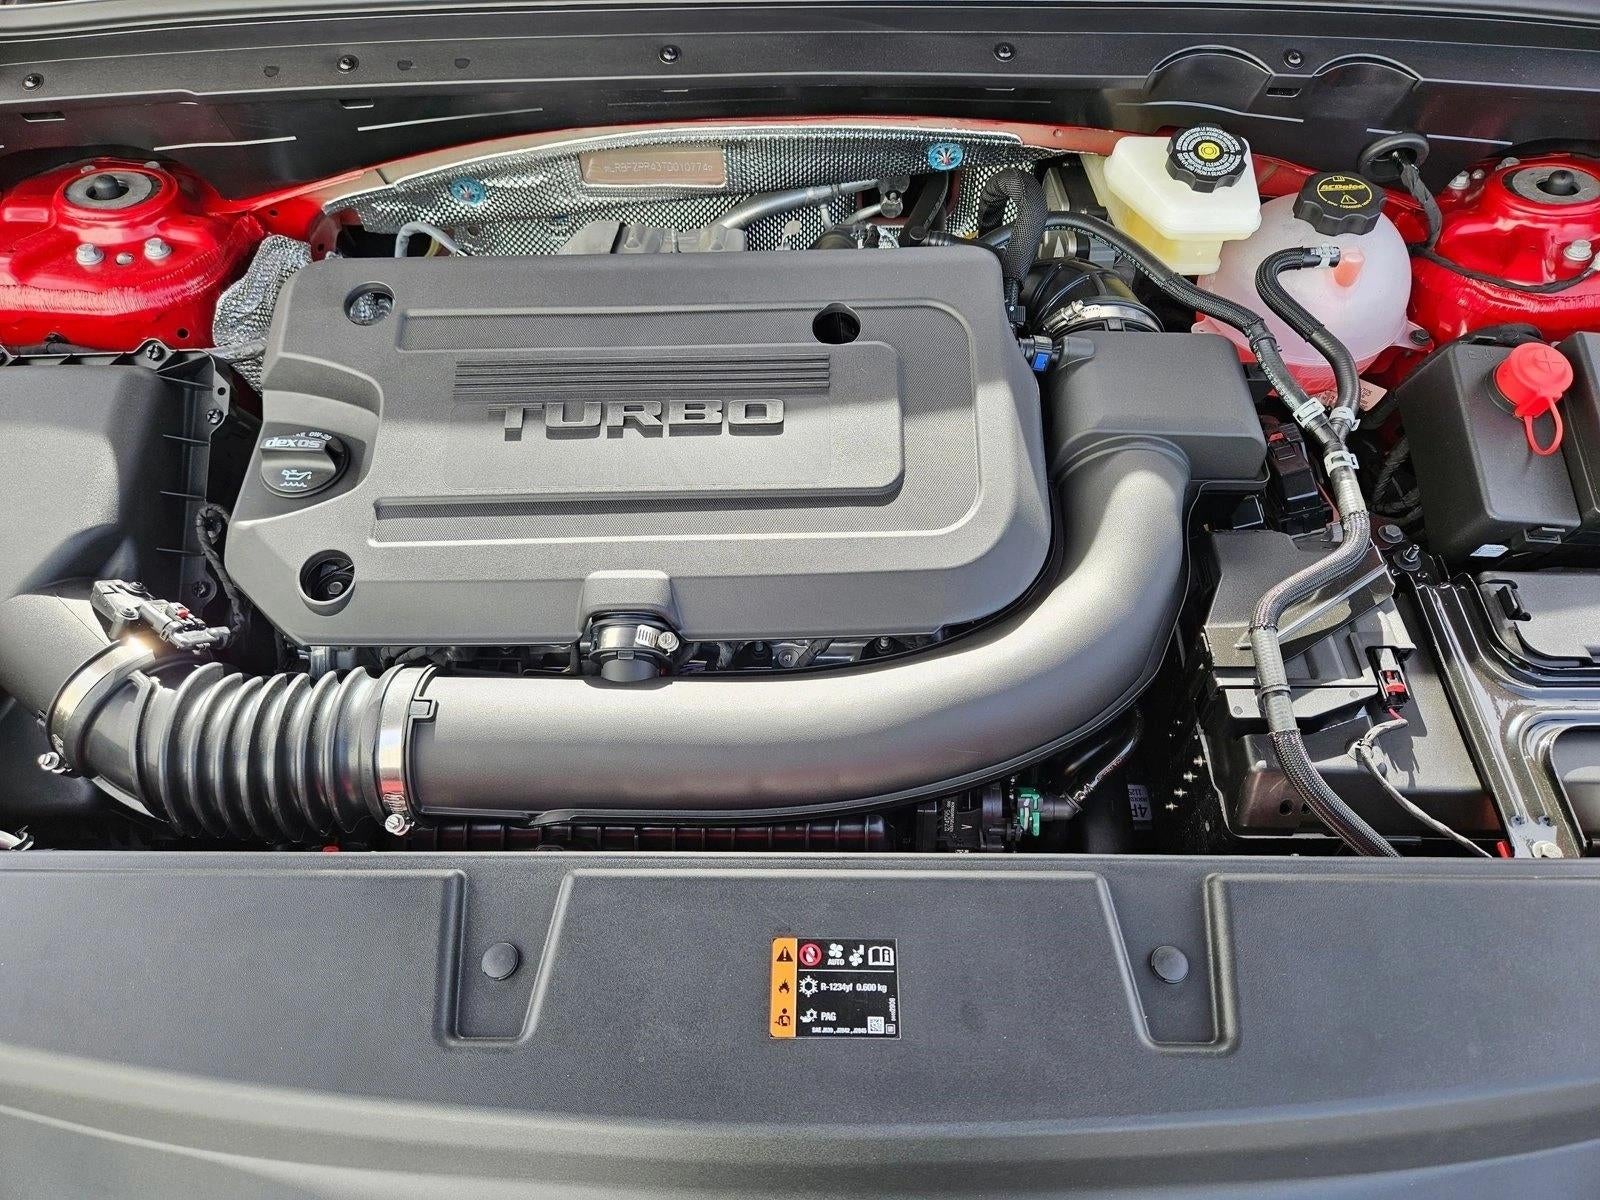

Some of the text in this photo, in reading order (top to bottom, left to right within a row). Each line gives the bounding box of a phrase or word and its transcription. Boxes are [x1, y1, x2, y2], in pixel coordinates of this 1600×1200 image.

[1320, 184, 1366, 192] ACDelco
[487, 399, 784, 440] TURBO
[265, 437, 321, 448] dexos
[827, 958, 845, 966] AUTO
[820, 982, 888, 994] R-1234yf 0.600 kg
[820, 1011, 837, 1021] PAG
